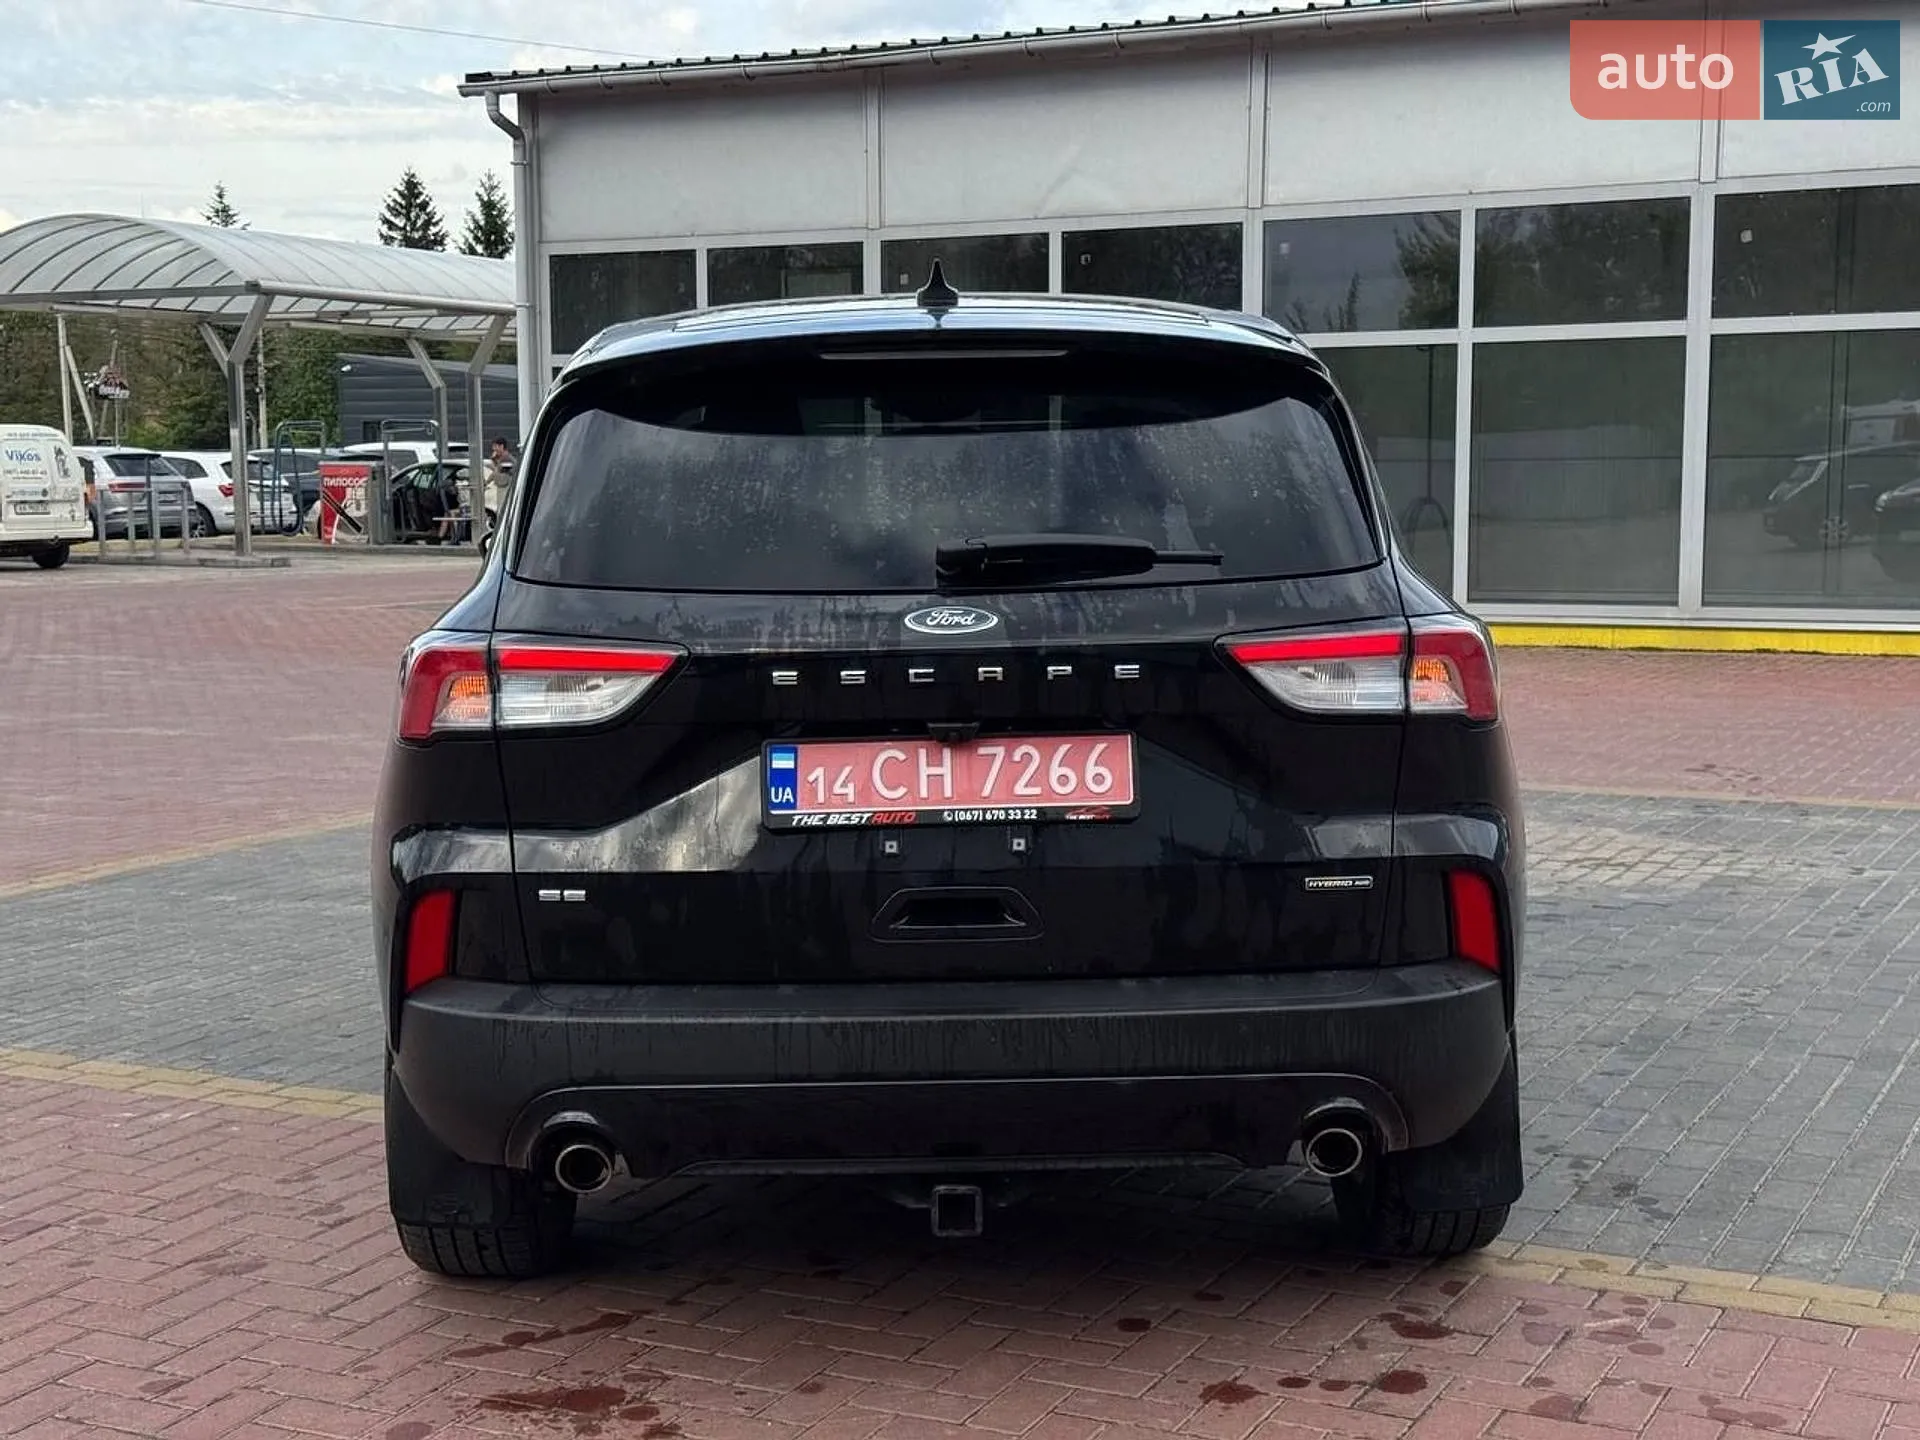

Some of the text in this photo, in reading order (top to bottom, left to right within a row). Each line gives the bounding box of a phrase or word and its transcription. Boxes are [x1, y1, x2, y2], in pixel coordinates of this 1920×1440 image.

[926, 610, 976, 626] Ford
[771, 664, 1141, 686] ESCAPE
[807, 742, 1115, 805] 14 CH 7266
[770, 786, 795, 804] UA
[792, 814, 827, 827] THE
[954, 809, 1038, 822] (067) 670 33 22
